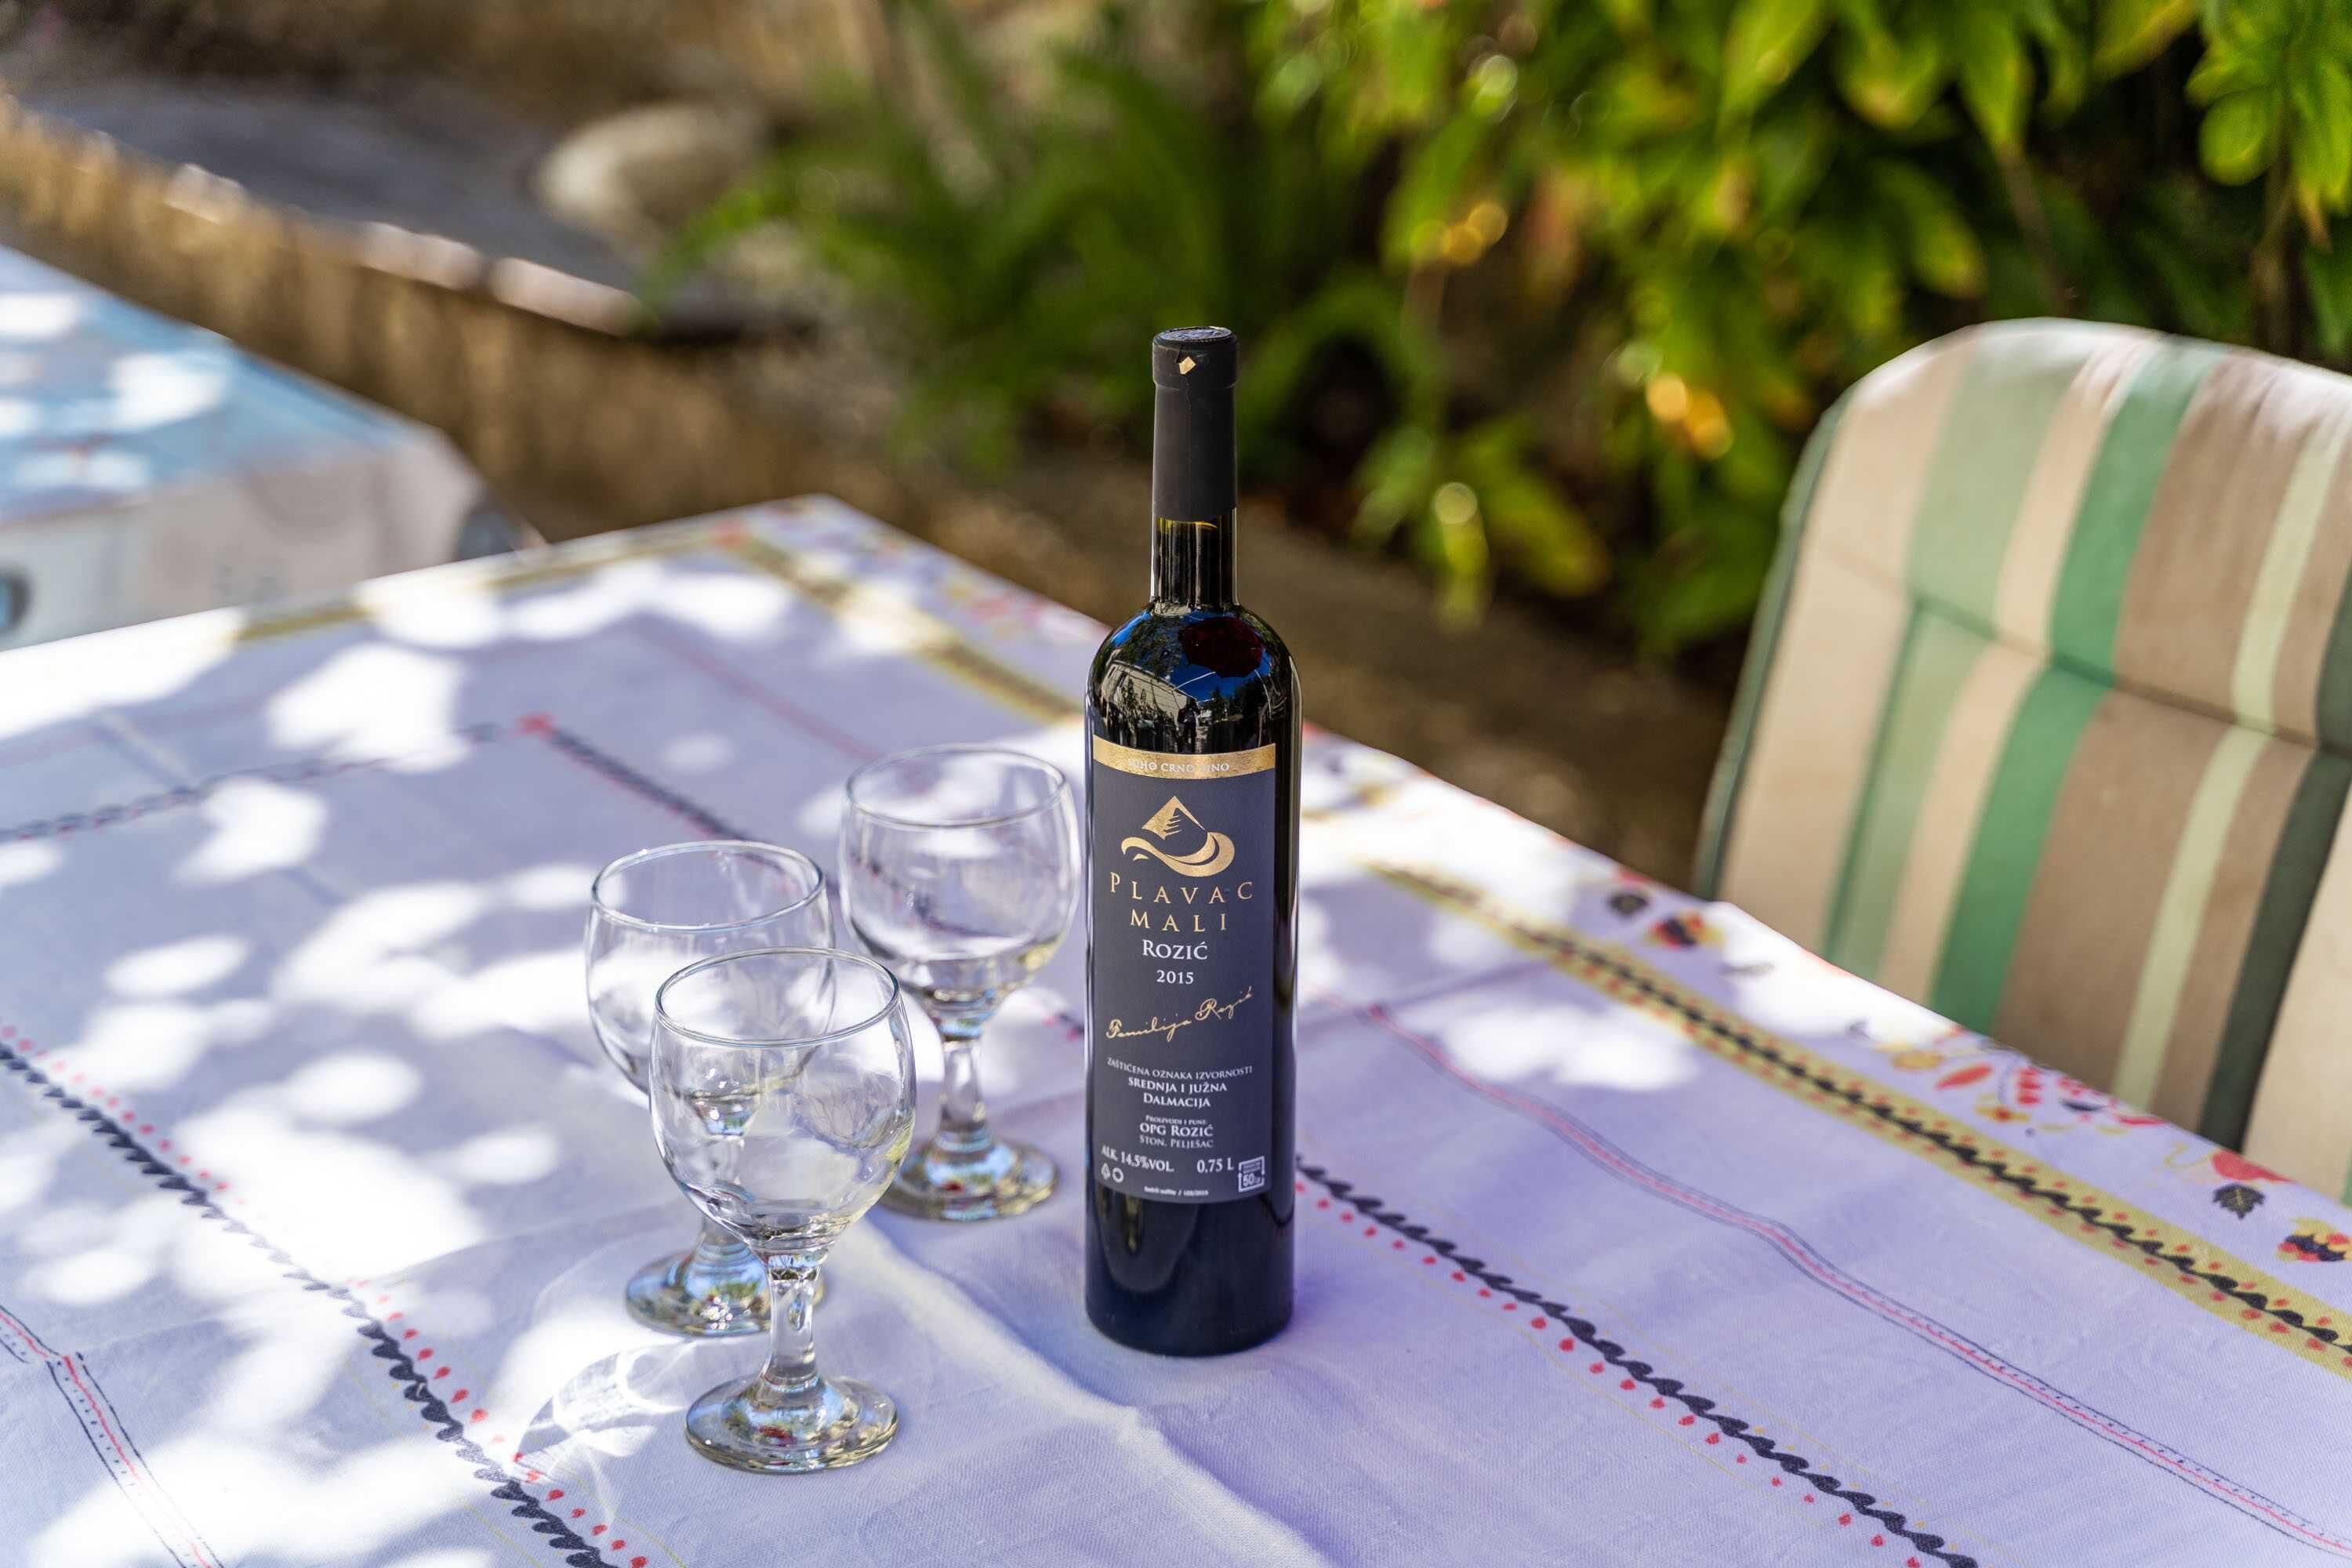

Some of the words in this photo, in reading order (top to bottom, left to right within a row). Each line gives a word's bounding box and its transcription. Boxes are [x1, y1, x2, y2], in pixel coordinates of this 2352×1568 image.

[1160, 762, 1195, 773] CRNO
[1109, 871, 1253, 905] PLAVAC
[1130, 909, 1228, 932] MALI
[1142, 938, 1208, 960] ROZIĆ
[1156, 969, 1194, 985] 2015
[1152, 1069, 1192, 1080] OZNAKA
[1196, 1065, 1253, 1080] IZVORNOSTI
[1127, 1076, 1178, 1094] SREDNJA
[1181, 1083, 1185, 1094] I
[1189, 1082, 1228, 1094] JUŽNA
[1142, 1092, 1211, 1109] DALMACIJA
[1139, 1122, 1167, 1136] OPG
[1171, 1124, 1214, 1137] ROZIĆ
[1196, 1159, 1223, 1174] 0.75
[1227, 1156, 1235, 1171] L
